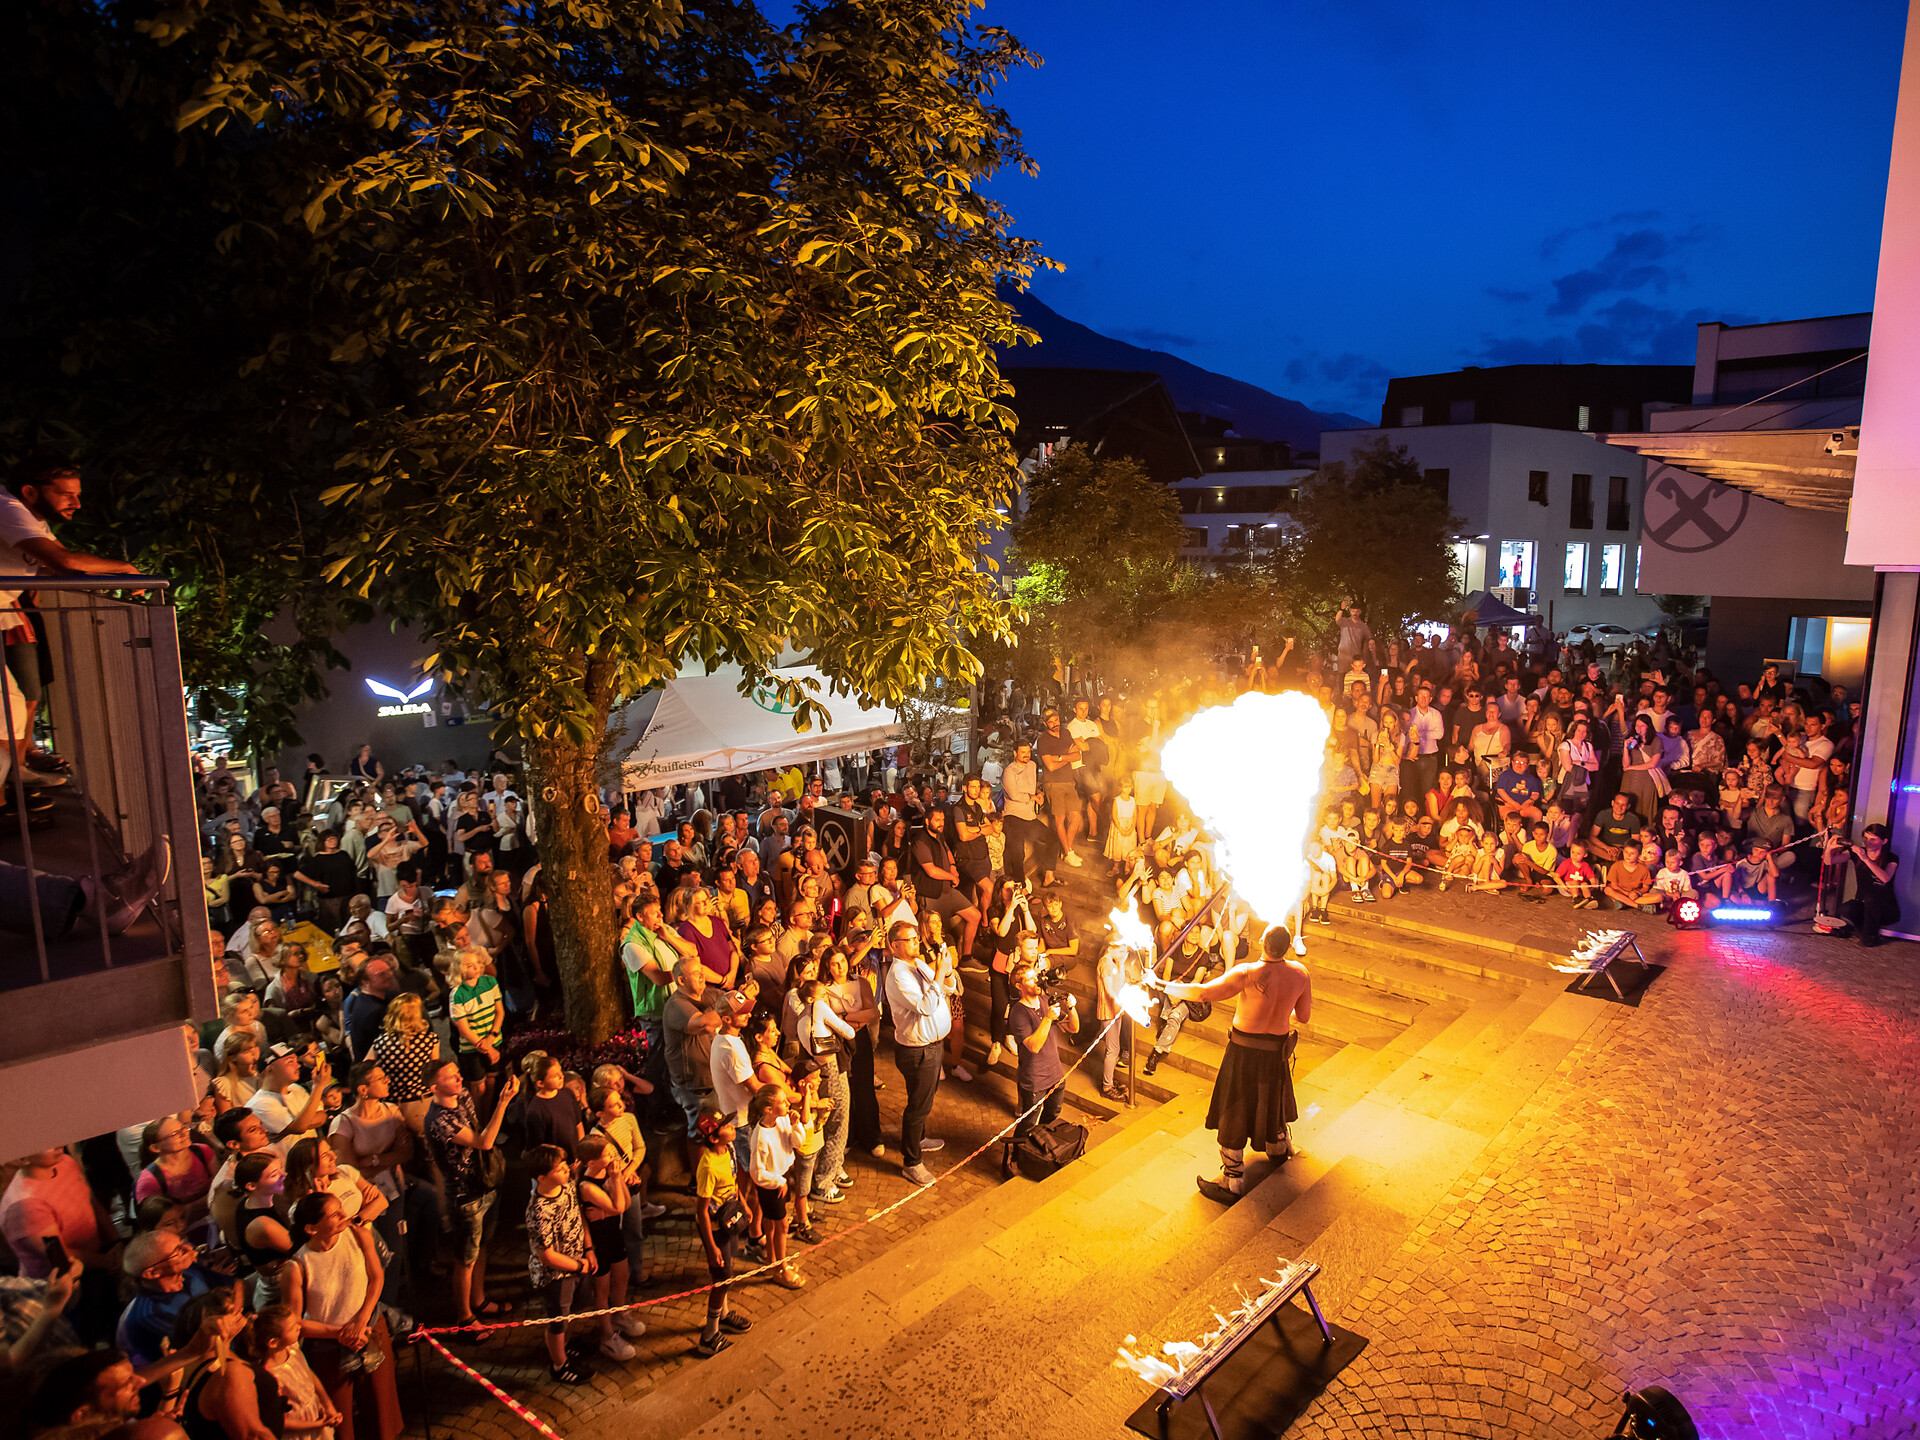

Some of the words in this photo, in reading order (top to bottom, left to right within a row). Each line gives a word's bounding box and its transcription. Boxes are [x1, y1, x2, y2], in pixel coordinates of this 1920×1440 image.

[1529, 592, 1536, 604] P
[653, 760, 704, 773] Raiffeisen
[726, 1211, 743, 1228] FILA
